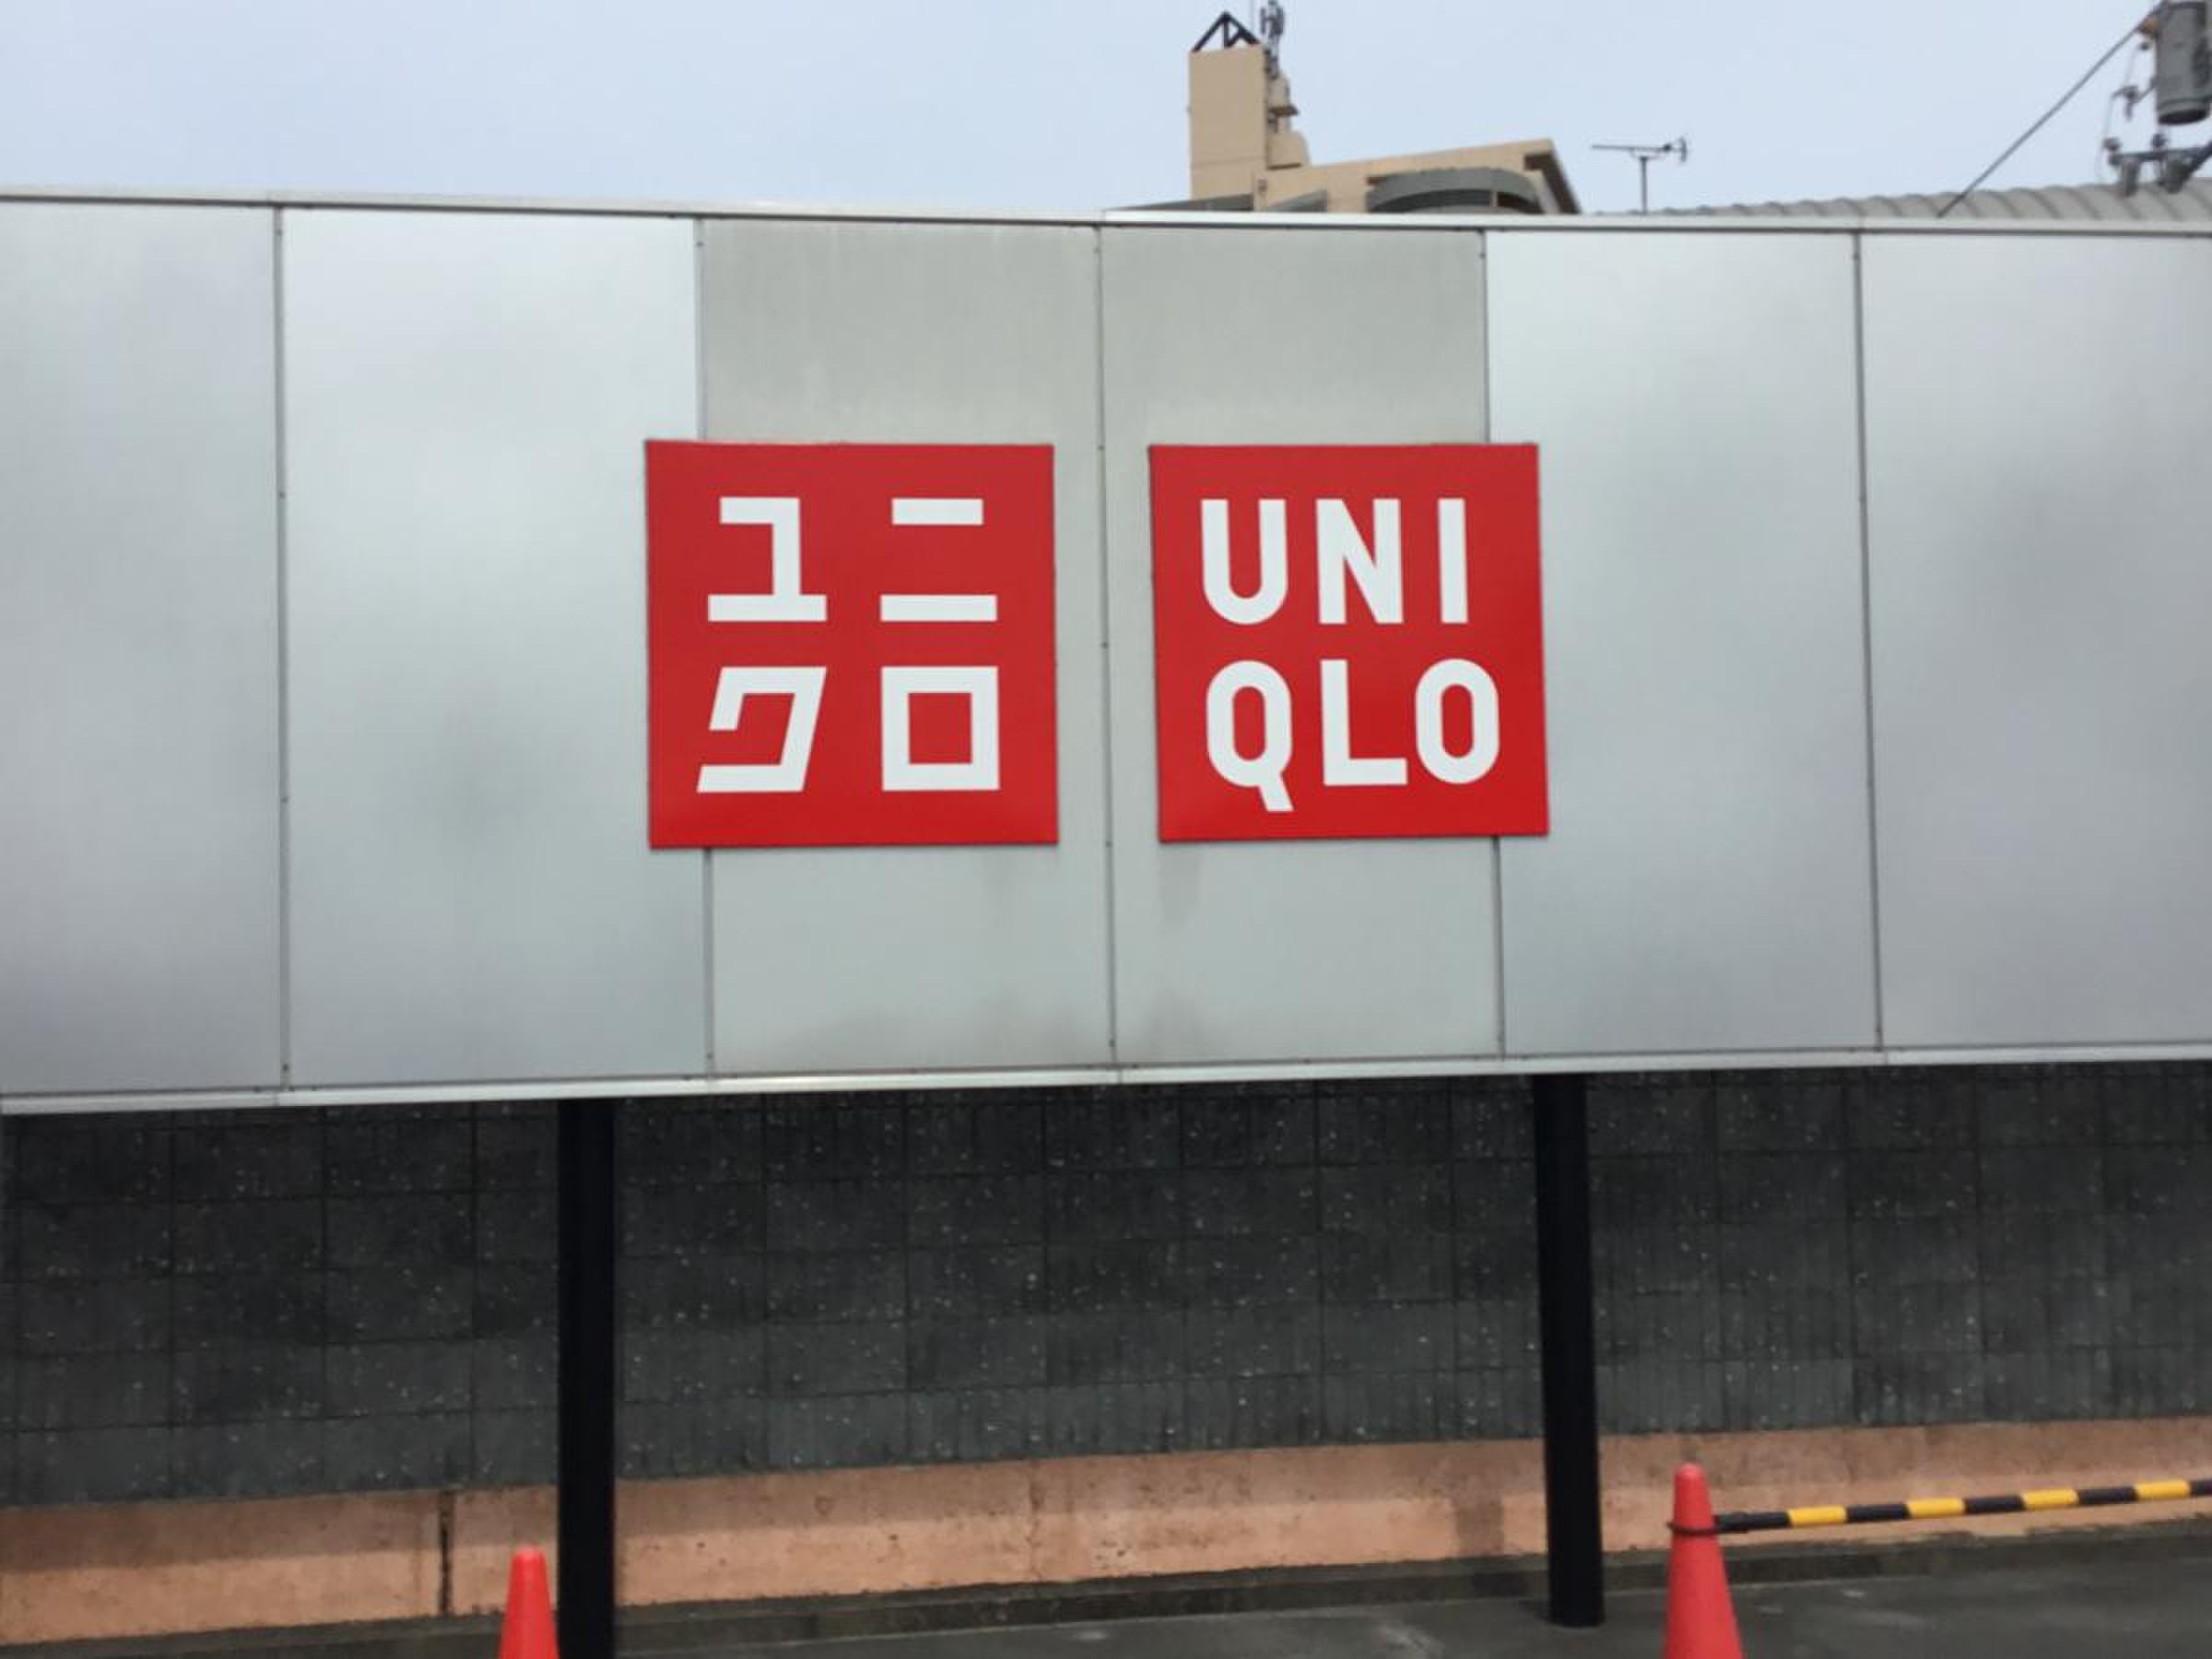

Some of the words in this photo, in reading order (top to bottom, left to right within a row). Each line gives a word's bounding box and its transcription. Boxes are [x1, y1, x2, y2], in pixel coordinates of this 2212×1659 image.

[707, 497, 998, 623] ユニ
[1200, 498, 1469, 625] UNI
[697, 665, 1000, 793] クロ
[1206, 658, 1500, 812] QLO
